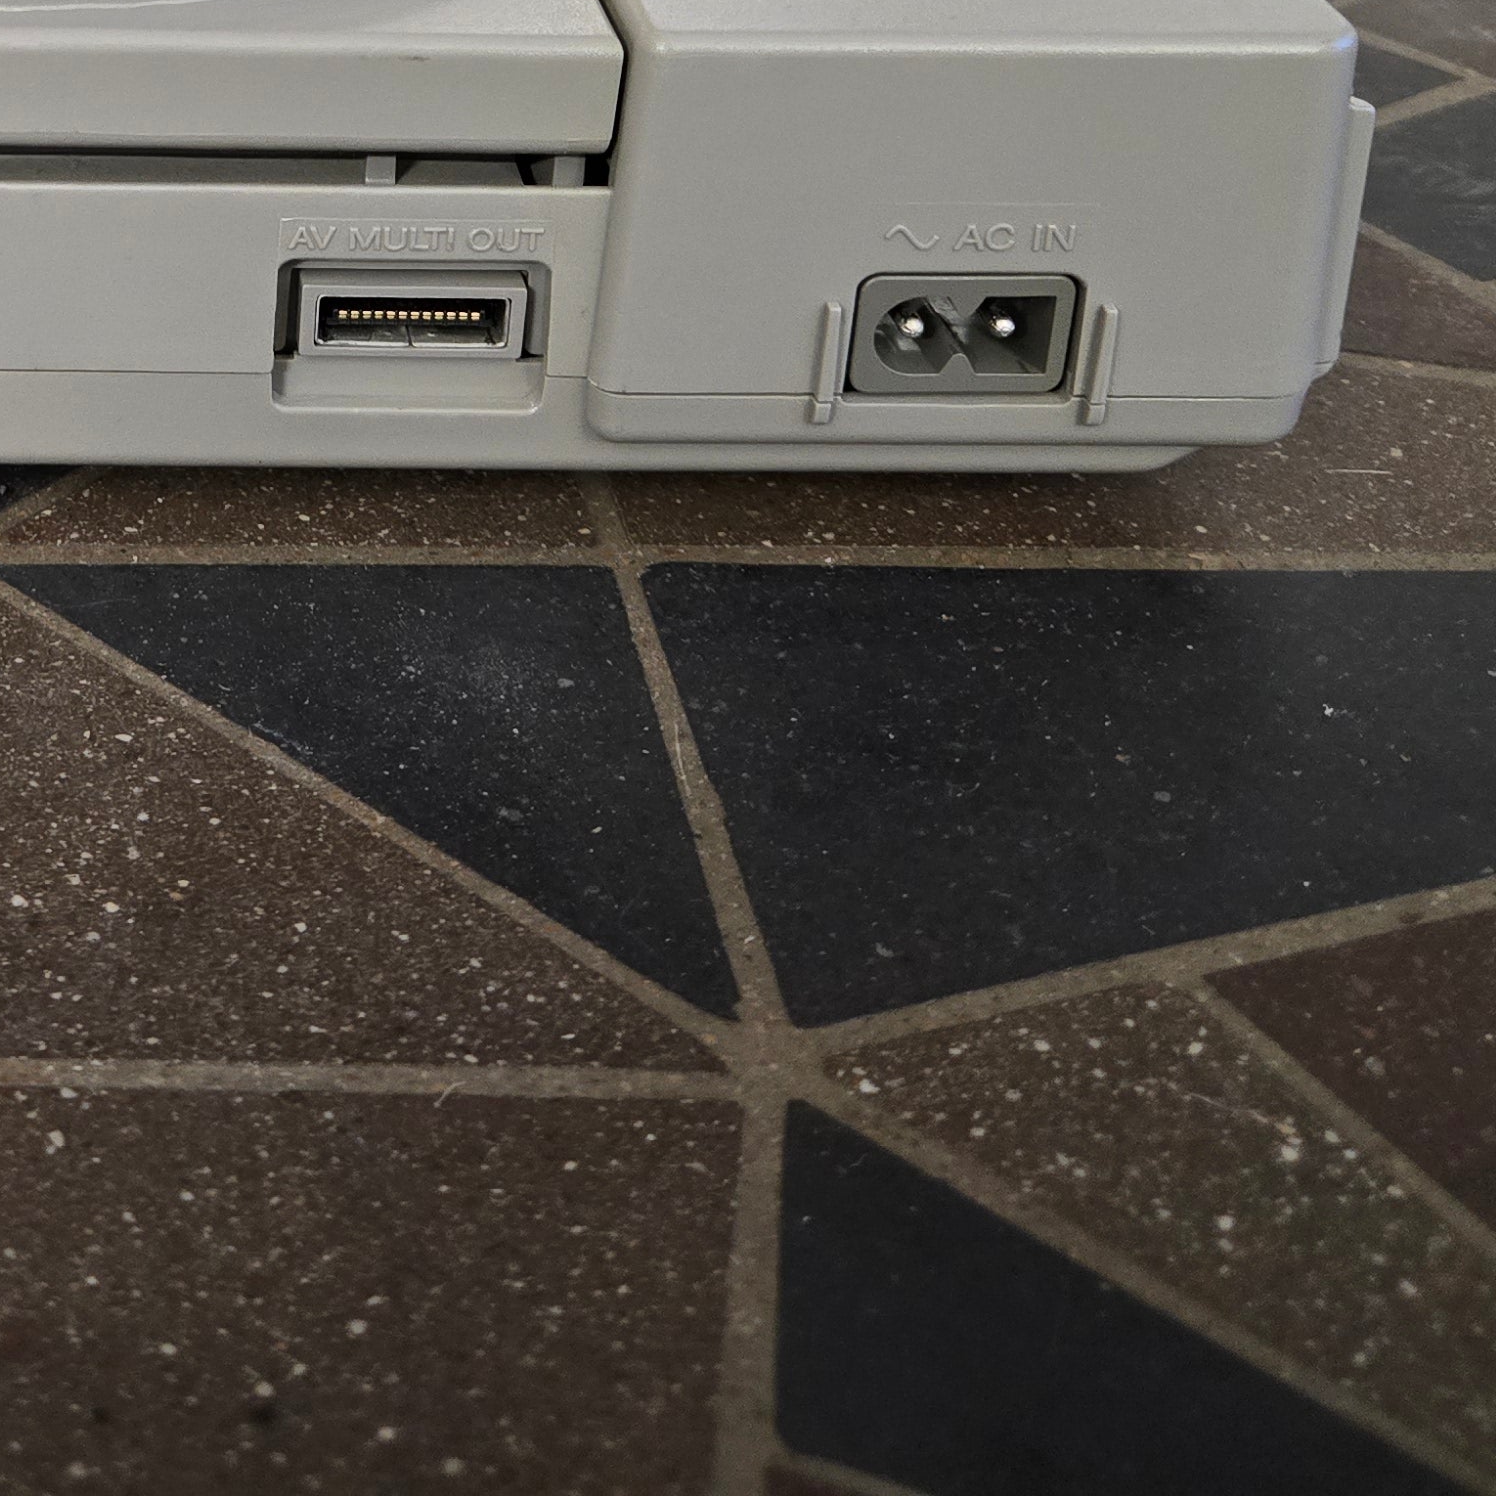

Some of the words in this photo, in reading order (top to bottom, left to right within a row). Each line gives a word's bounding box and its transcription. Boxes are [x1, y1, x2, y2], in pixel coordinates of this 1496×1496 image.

[287, 225, 337, 252] AV
[349, 226, 456, 252] MULTI
[467, 226, 546, 253] OUT
[952, 222, 1016, 252] AC
[1031, 223, 1077, 253] IN
